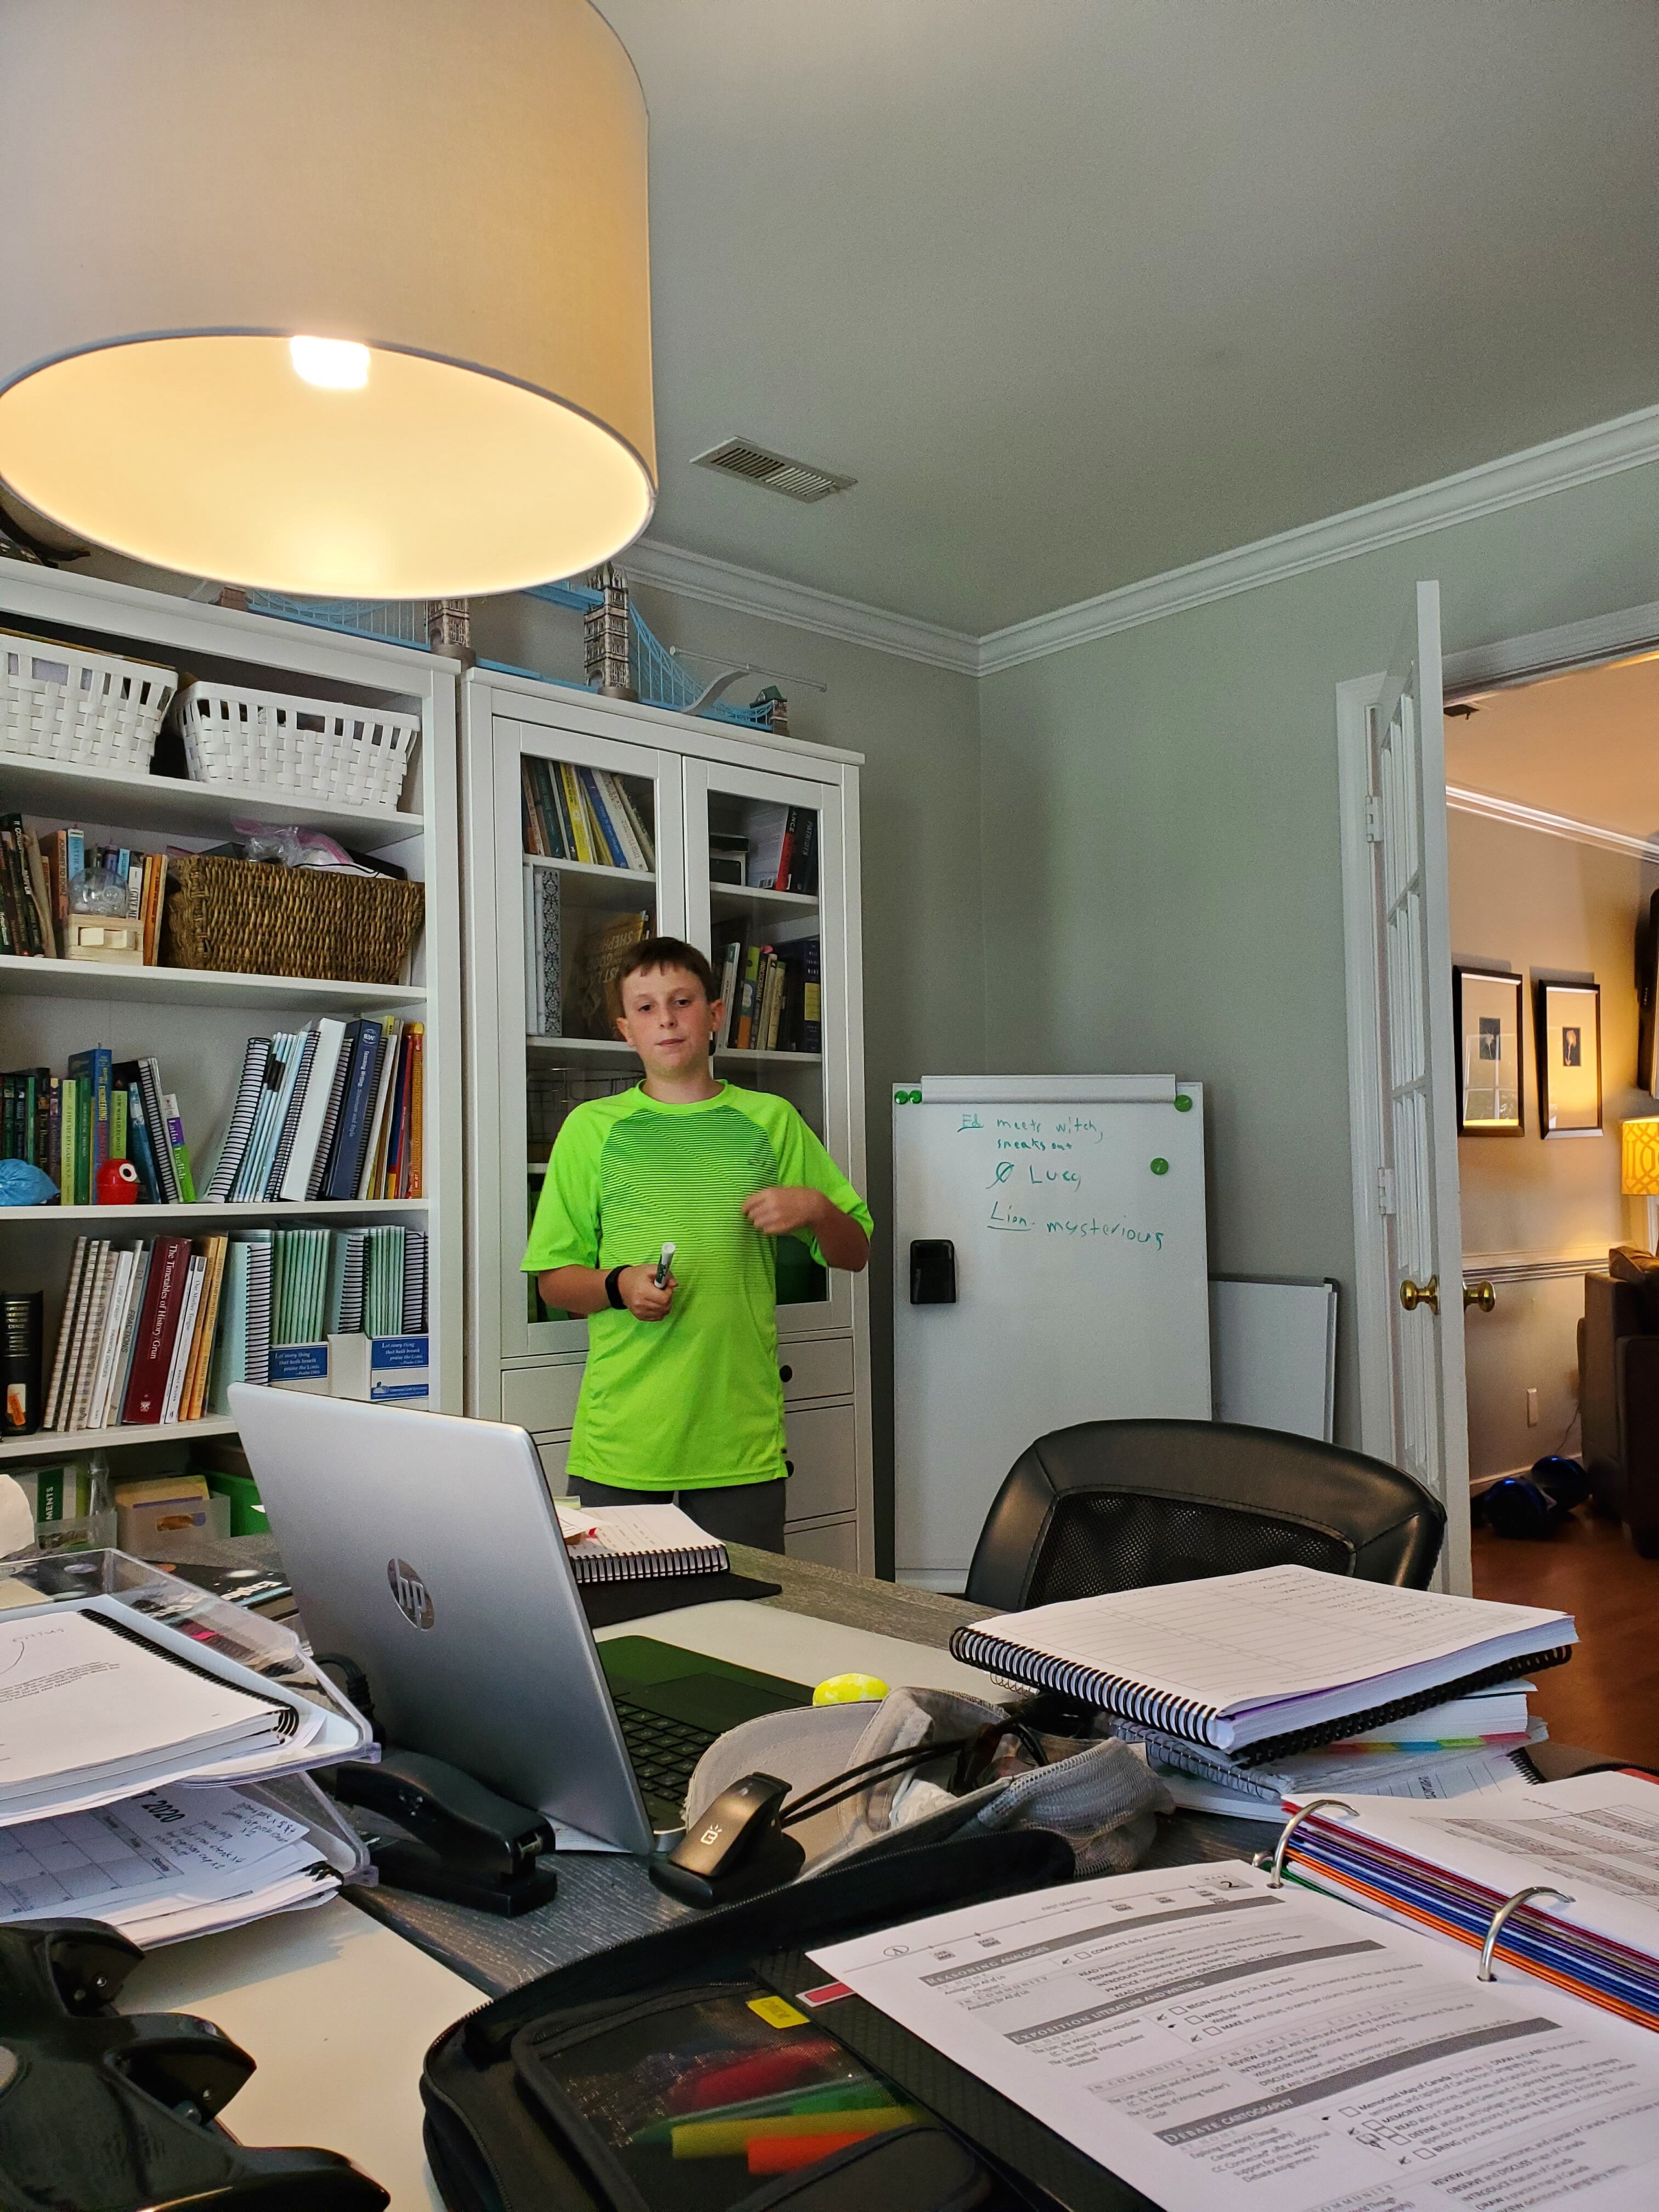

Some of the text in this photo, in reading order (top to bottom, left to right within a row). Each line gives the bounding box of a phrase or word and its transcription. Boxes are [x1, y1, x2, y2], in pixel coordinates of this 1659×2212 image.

[803, 820, 813, 856] PATRIOTS
[59, 867, 65, 876] TO
[360, 1049, 370, 1070] Teaching
[98, 1085, 107, 1121] ENGINEERING
[353, 1088, 363, 1113] Structure
[168, 1119, 178, 1143] Latin
[348, 1124, 357, 1138] Style
[960, 1113, 983, 1129] Ed
[997, 1118, 1041, 1133] meets
[997, 1137, 1046, 1151] sneaks
[173, 1147, 185, 1180] English
[1046, 1215, 1164, 1251] mysterious
[167, 1243, 178, 1259] The
[159, 1259, 175, 1300] Timetables
[193, 1279, 201, 1291] Our
[159, 1300, 168, 1310] of
[189, 1291, 199, 1312] Mother
[184, 1311, 194, 1331] Tongue
[120, 1308, 136, 1354] FRACTIONS
[106, 1329, 116, 1354] FINANCIAL
[101, 1355, 111, 1378] CHOICES
[394, 1557, 427, 1629] hp
[141, 1799, 185, 1823] 2020
[151, 1857, 170, 1872] Saturday
[1220, 1880, 1240, 1889] 2
[1091, 1941, 1128, 1955] COMPLETE
[926, 1946, 1051, 1985] REASONING ANALOGIES
[1078, 1966, 1099, 1977] READ
[1087, 1969, 1118, 1982] PREPARE
[1096, 1971, 1138, 1987] INTRODUCE
[1114, 1963, 1227, 1998] READ IDENTIFY
[972, 1983, 1001, 1995] Chapter
[976, 1975, 1048, 2002] COMMUNITY
[1104, 1980, 1138, 1993] PRACTICE
[1011, 1979, 1205, 2042] EXPOSITION LITERATURE AND WRITING
[1186, 2000, 1211, 2010] BEGIN
[1201, 2008, 1227, 2019] WRITE
[1220, 2019, 1244, 2031] MAKE
[1227, 2054, 1258, 2068] REVIEW
[1238, 2055, 1285, 2074] INTRODUCE
[1088, 2059, 1186, 2093] IN COMMUNITY
[1259, 2072, 1294, 2087] DISCUSS
[1270, 2085, 1288, 2094] USE
[1358, 2074, 1453, 2112] Memorized Map Canada
[1163, 2097, 1295, 2145] DEBATE CARTOGRAPHY
[1381, 2104, 1426, 2124] MEMORIZE
[1394, 2120, 1418, 2131] READ
[1407, 2124, 1437, 2139] DEFINE
[1432, 2140, 1462, 2153] BRING
[1211, 2164, 1226, 2174] CC
[1242, 2169, 1273, 2183] Debate
[1446, 2159, 1533, 2195] OBSERVE DISCUSS
[1431, 2171, 1465, 2186] REVIEW
[1462, 2180, 1511, 2202] INTRODUCE
[1475, 2197, 1505, 2211] DRAW
